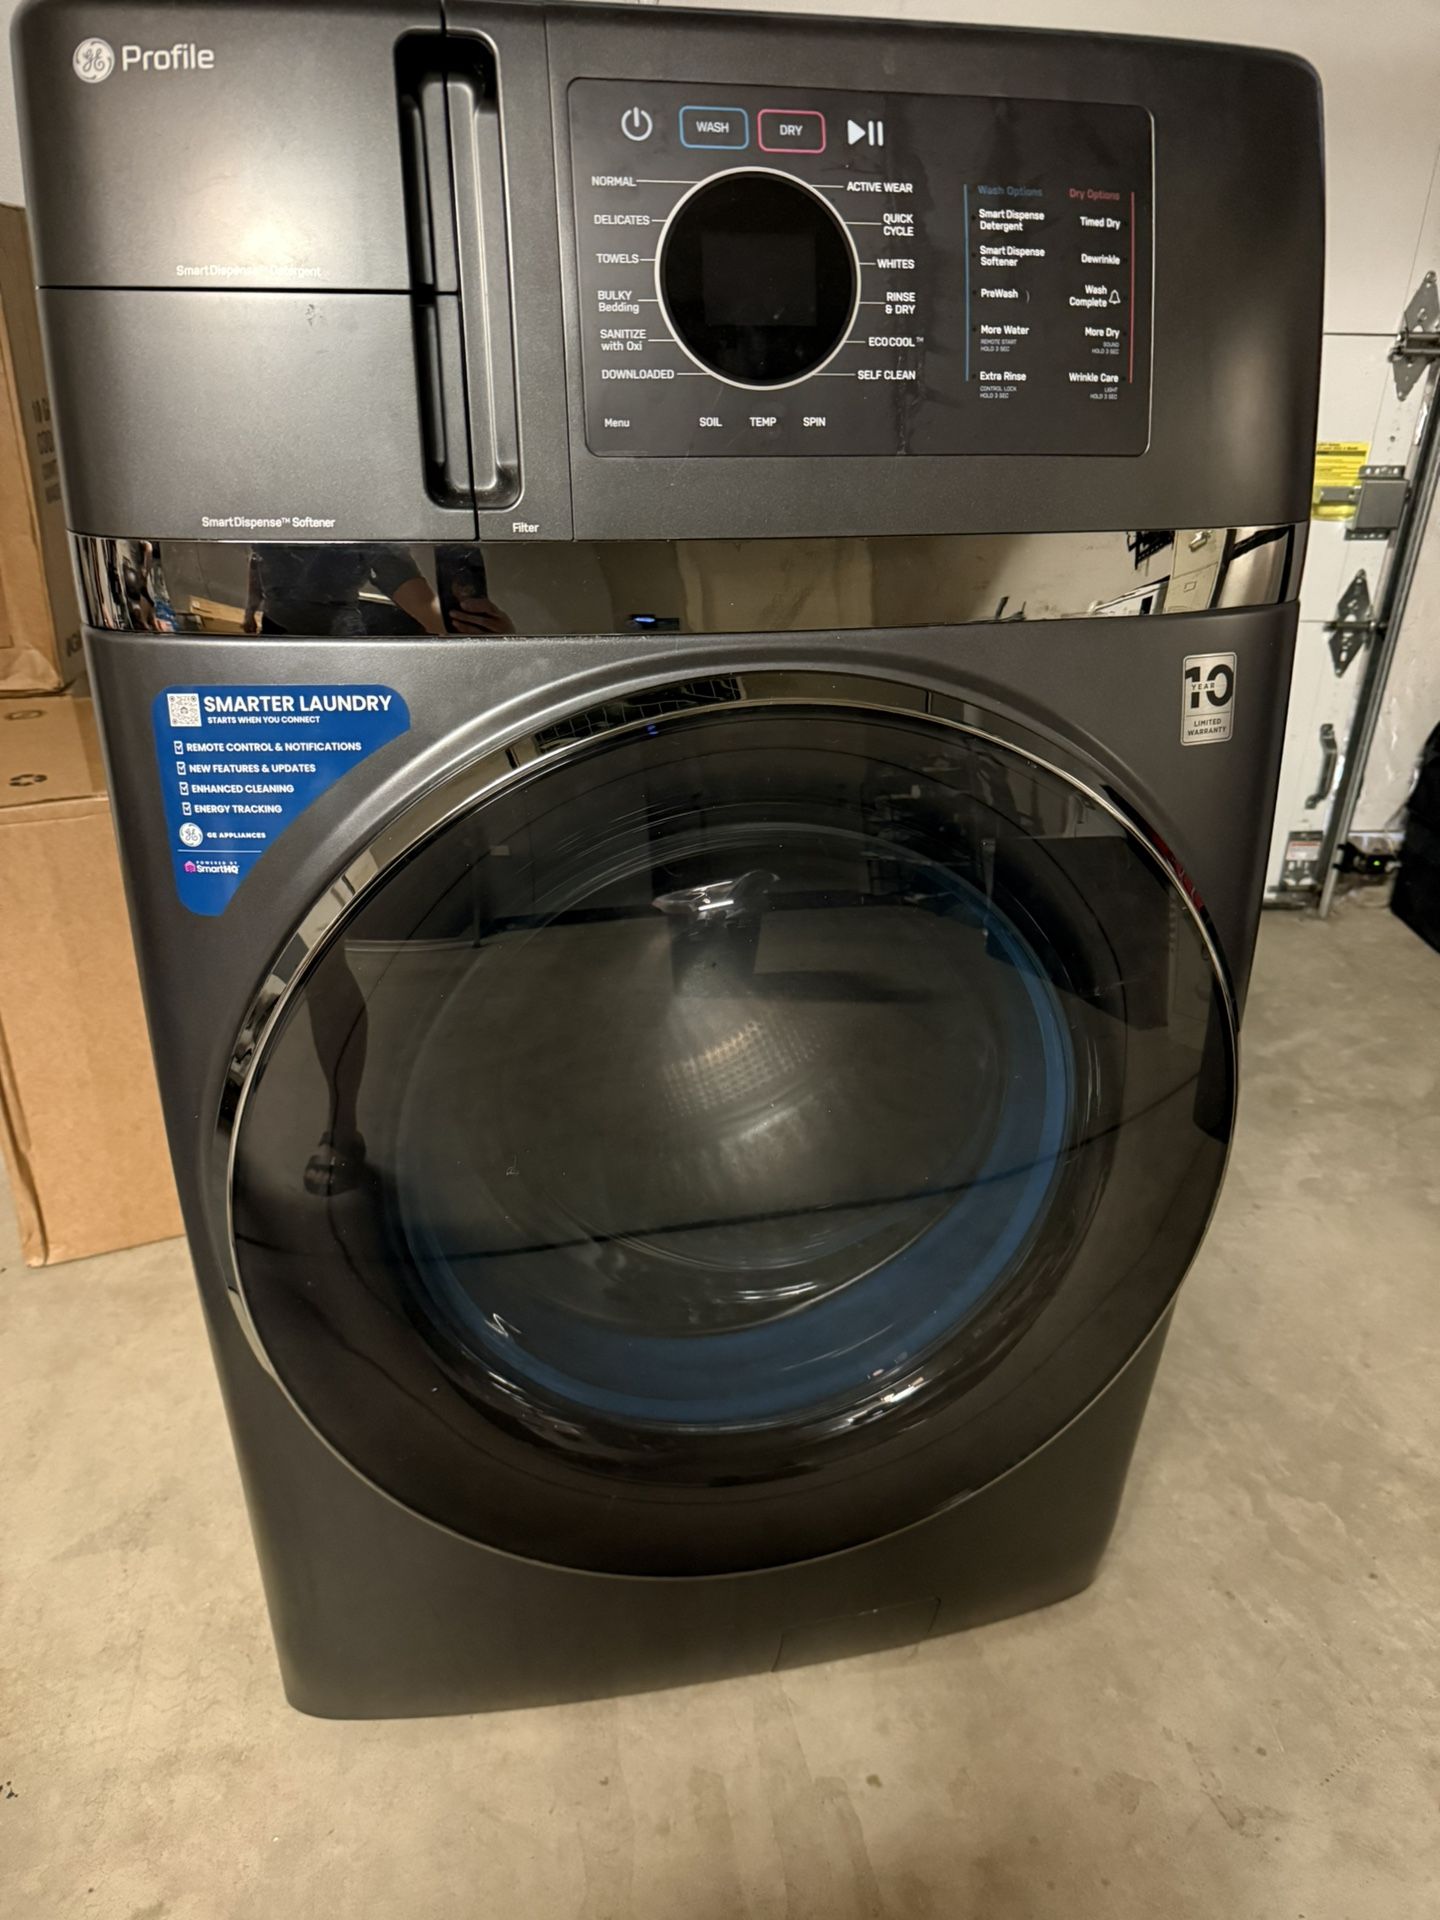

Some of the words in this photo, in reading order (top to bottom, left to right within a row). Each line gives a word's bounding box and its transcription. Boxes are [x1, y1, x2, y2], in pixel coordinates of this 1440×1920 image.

[122, 43, 215, 71] Profile
[696, 121, 729, 133] WASH
[779, 124, 803, 136] DRY
[591, 176, 637, 187] NORMAL
[847, 181, 882, 193] ACTIVE
[883, 182, 914, 194] WEAR
[977, 185, 1005, 196] Wash
[1006, 185, 1043, 198] Options
[1069, 188, 1085, 200] Dry
[1087, 189, 1120, 201] Options
[594, 214, 650, 226] DELICATES
[883, 213, 914, 225] QUICK
[979, 208, 1005, 220] Smart
[1006, 209, 1045, 222] Dispense
[979, 221, 1024, 233] Detergent
[1080, 216, 1105, 228] Timed
[1106, 218, 1121, 231] Dry
[883, 226, 914, 237] CYCLE
[979, 245, 1005, 256] Smart
[1006, 245, 1045, 258] Dispense
[596, 253, 639, 264] TOWELS
[877, 258, 915, 270] WHITES
[980, 257, 1018, 268] Softener
[1081, 253, 1121, 265] Dewrinkle
[980, 288, 1019, 299] PreWash
[1085, 284, 1108, 295] Wash
[597, 290, 632, 301] BULKY
[886, 291, 916, 302] RINSE
[598, 302, 640, 314] Bedding
[1069, 296, 1108, 309] Complete
[885, 304, 893, 315] &
[895, 304, 916, 315] DRY
[600, 329, 647, 340] SANITIZE
[980, 325, 1002, 336] More
[1003, 325, 1030, 336] Water
[1084, 327, 1105, 337] More
[1106, 328, 1120, 340] Dry
[601, 340, 624, 351] with
[626, 340, 643, 351] Oxi
[601, 369, 675, 380] DOWNLOADED
[857, 370, 882, 380] SELF
[883, 370, 916, 381] CLEAN
[979, 371, 1002, 381] Extra
[1003, 371, 1027, 381] Rinse
[1069, 372, 1099, 383] Wrinkle
[1100, 373, 1119, 383] Care
[604, 418, 630, 428] Menu
[699, 417, 723, 428] SOIL
[749, 417, 777, 427] TEMP
[802, 416, 827, 427] SPIN
[292, 516, 336, 528] Softener
[512, 522, 540, 533] Filter
[1185, 663, 1234, 709] 10
[1191, 682, 1215, 691] YEAR
[204, 695, 295, 712] SMARTER
[300, 695, 392, 711] LAUNDRY
[207, 716, 237, 724] STARTS
[237, 716, 262, 724] WHEN
[263, 716, 281, 724] YOU
[281, 715, 320, 724] CONNECT
[1193, 718, 1222, 727] LIMITED
[1188, 726, 1226, 736] WARRANTY
[186, 743, 225, 752] REMOTE
[226, 742, 273, 752] CONTROL
[275, 743, 283, 752] &
[285, 742, 362, 752] NOTIFICATIONS
[189, 764, 212, 774] NEW
[213, 764, 260, 773] FEATURES
[261, 764, 270, 773] &
[272, 763, 316, 773] UPDATES
[191, 784, 243, 793] ENHANCED
[245, 784, 295, 793] CLEANING
[194, 805, 230, 814] ENERGY
[232, 804, 283, 814] TRACKING
